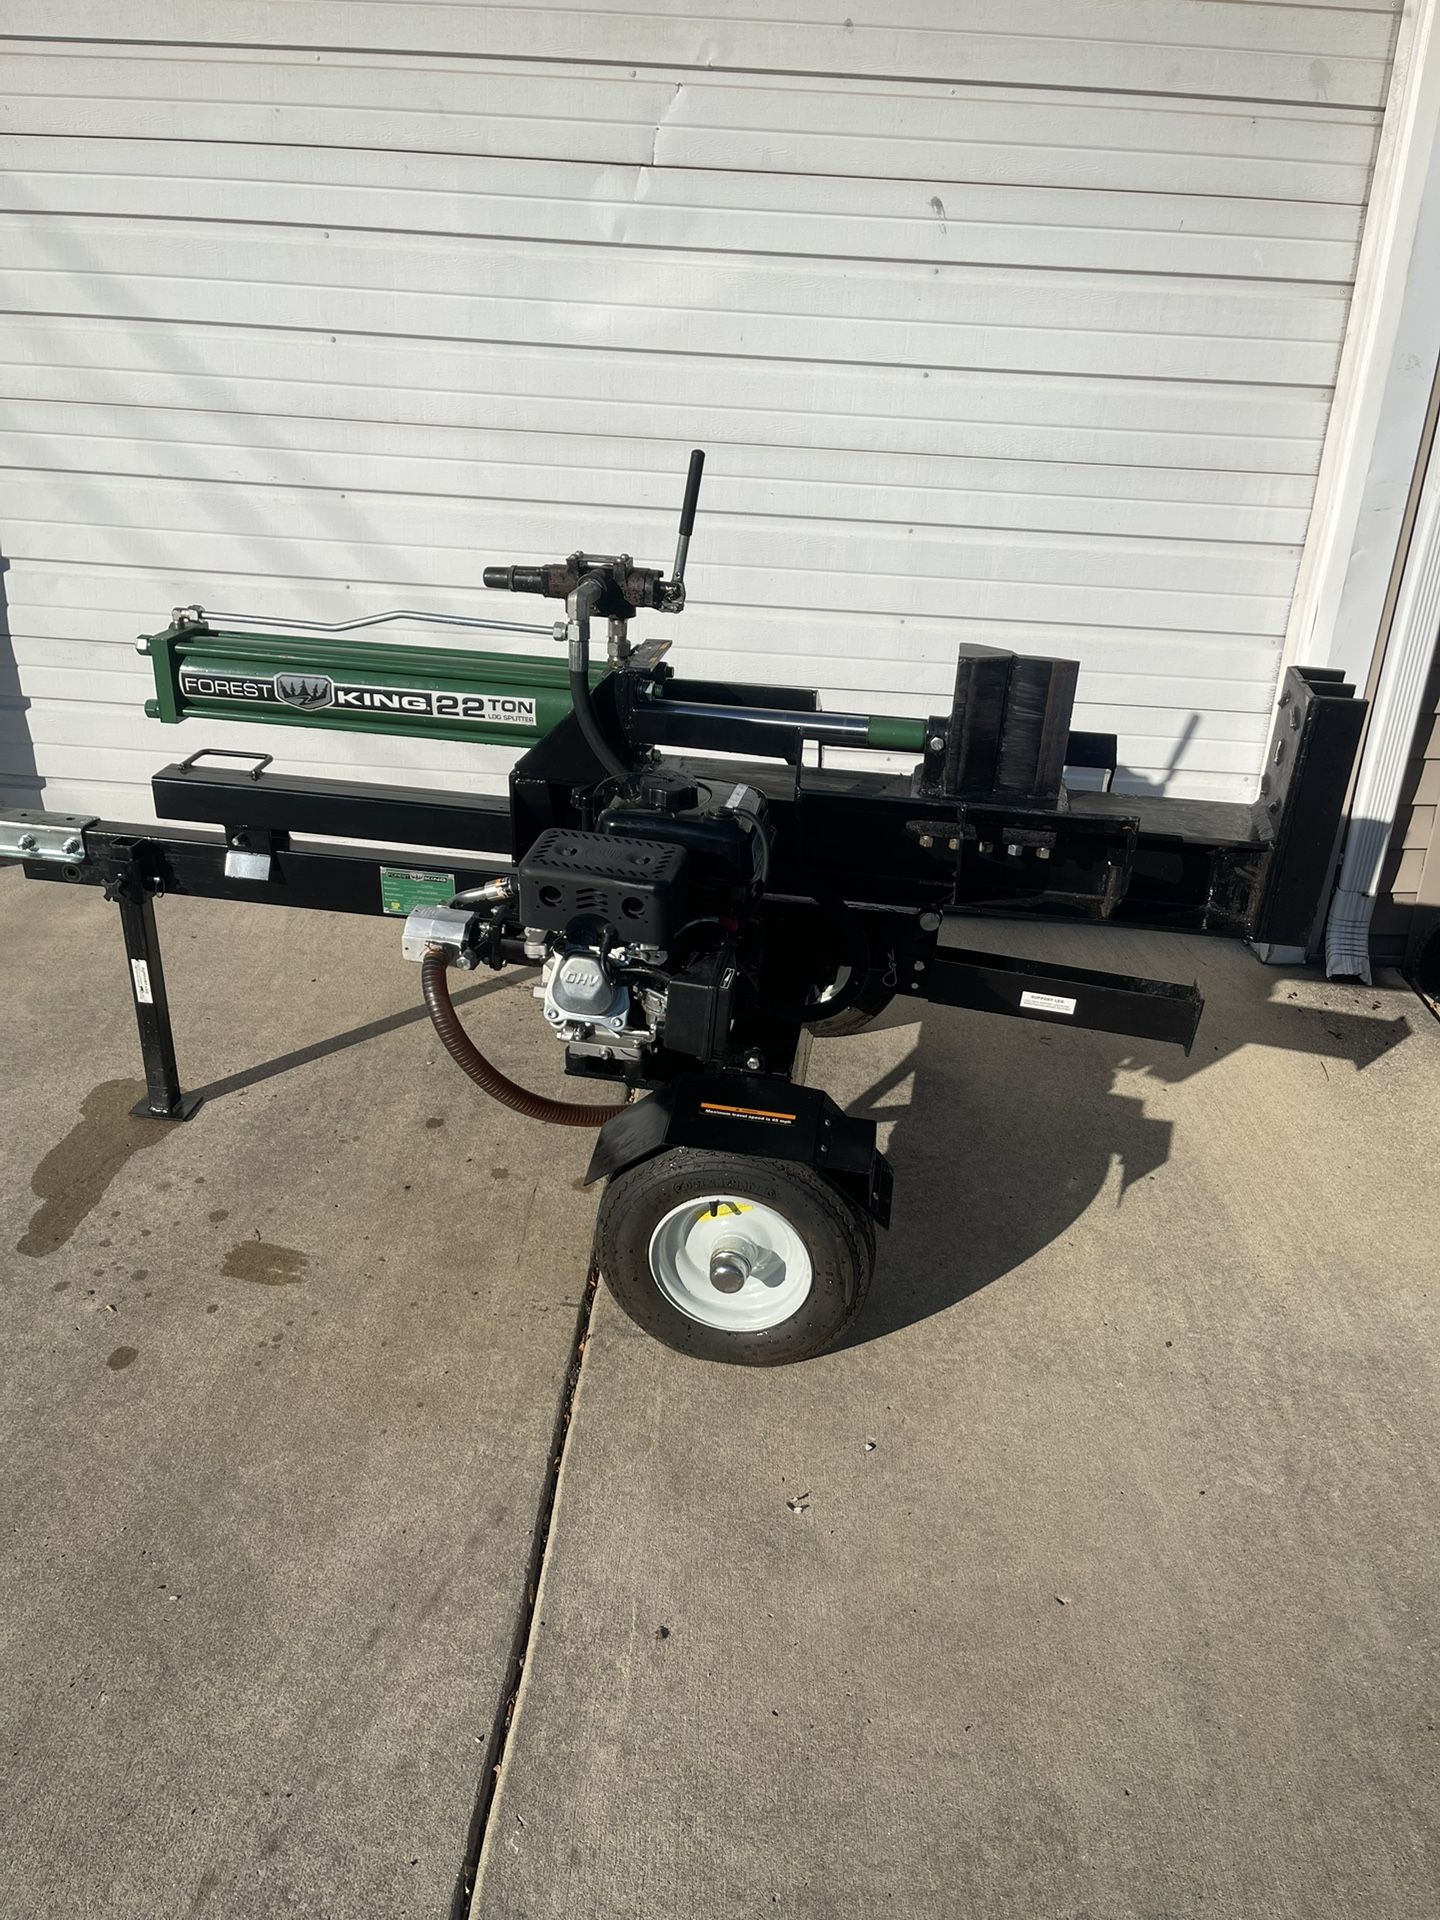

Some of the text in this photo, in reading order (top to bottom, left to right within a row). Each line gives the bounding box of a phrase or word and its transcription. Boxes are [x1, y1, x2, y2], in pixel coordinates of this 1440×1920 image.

[184, 677, 272, 698] FOREST
[436, 694, 486, 718] 22
[487, 698, 533, 714] TON
[503, 714, 534, 723] SPLITTER
[565, 972, 599, 987] OHV
